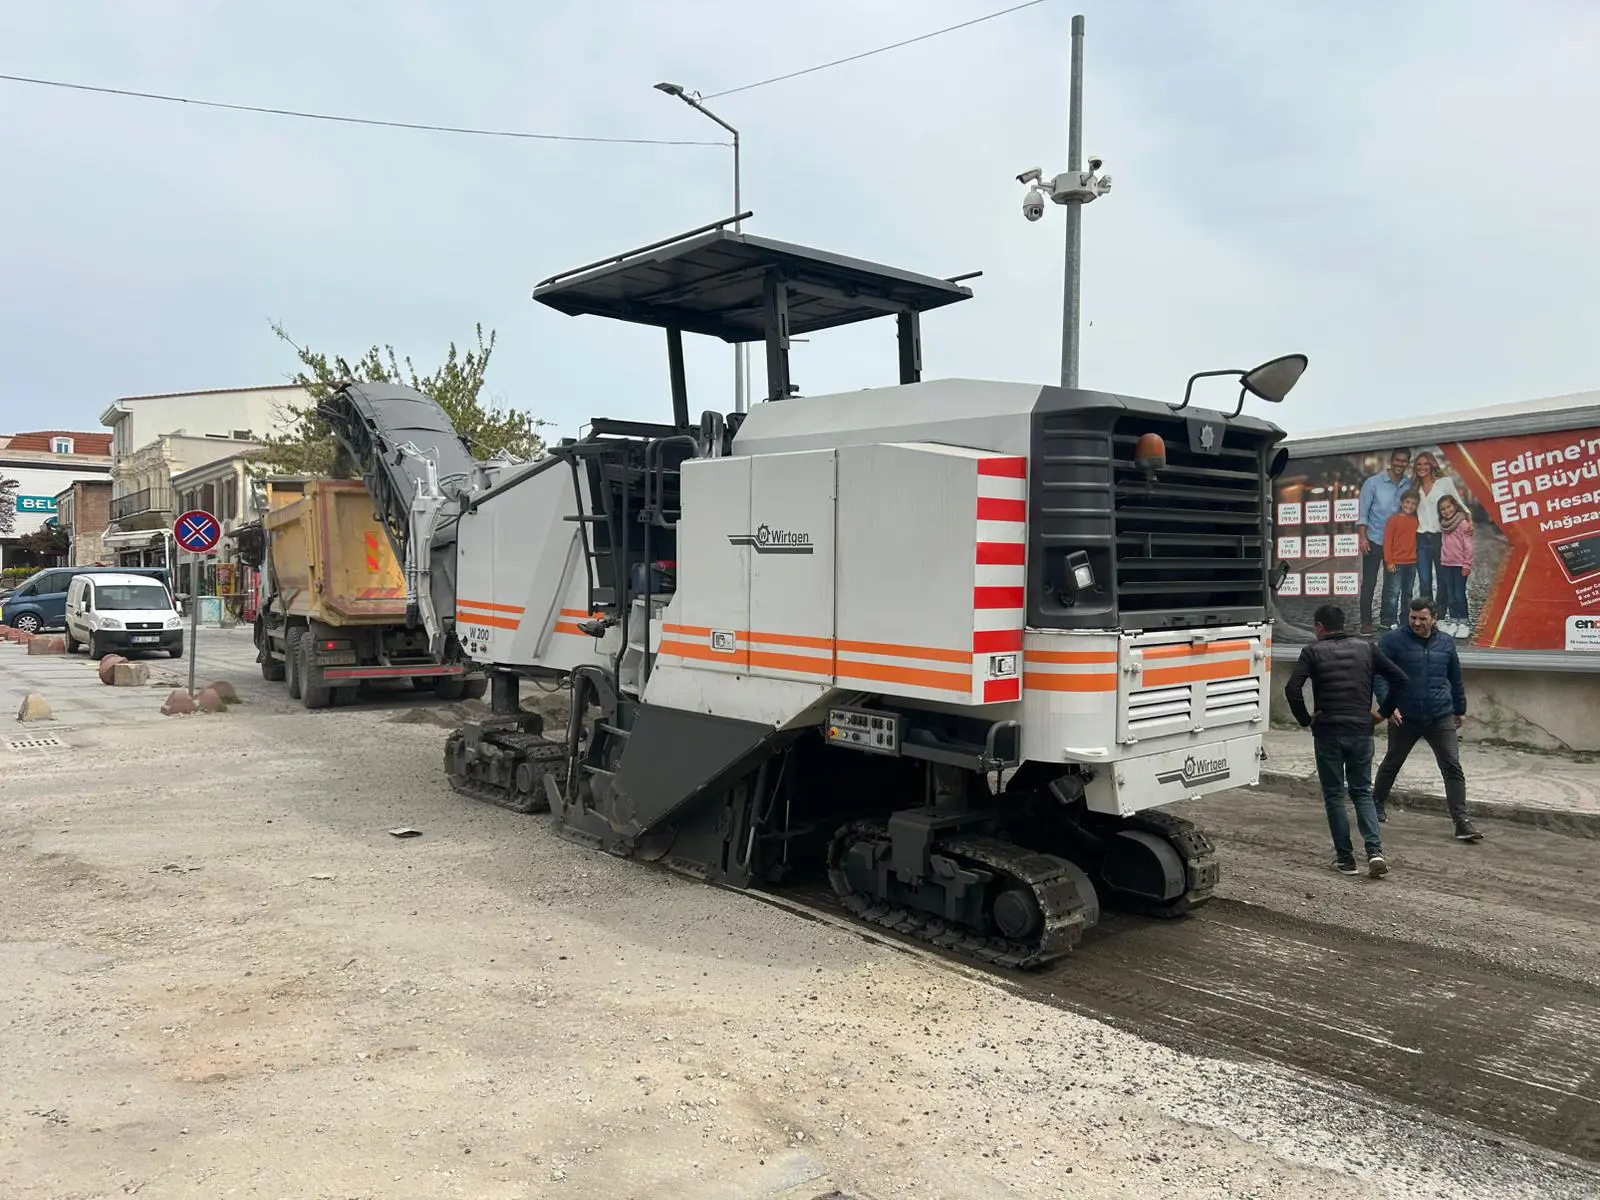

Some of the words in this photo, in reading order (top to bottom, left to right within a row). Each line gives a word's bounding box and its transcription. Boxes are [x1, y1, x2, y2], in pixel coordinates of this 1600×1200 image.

[1491, 480, 1532, 503] En
[1535, 459, 1600, 491] Büyü
[1500, 501, 1539, 524] En
[1540, 511, 1600, 532] Mağaza
[772, 530, 809, 546] Wirtgen
[469, 626, 476, 638] W
[477, 628, 489, 640] 200
[1196, 758, 1227, 773] Wirtgen
